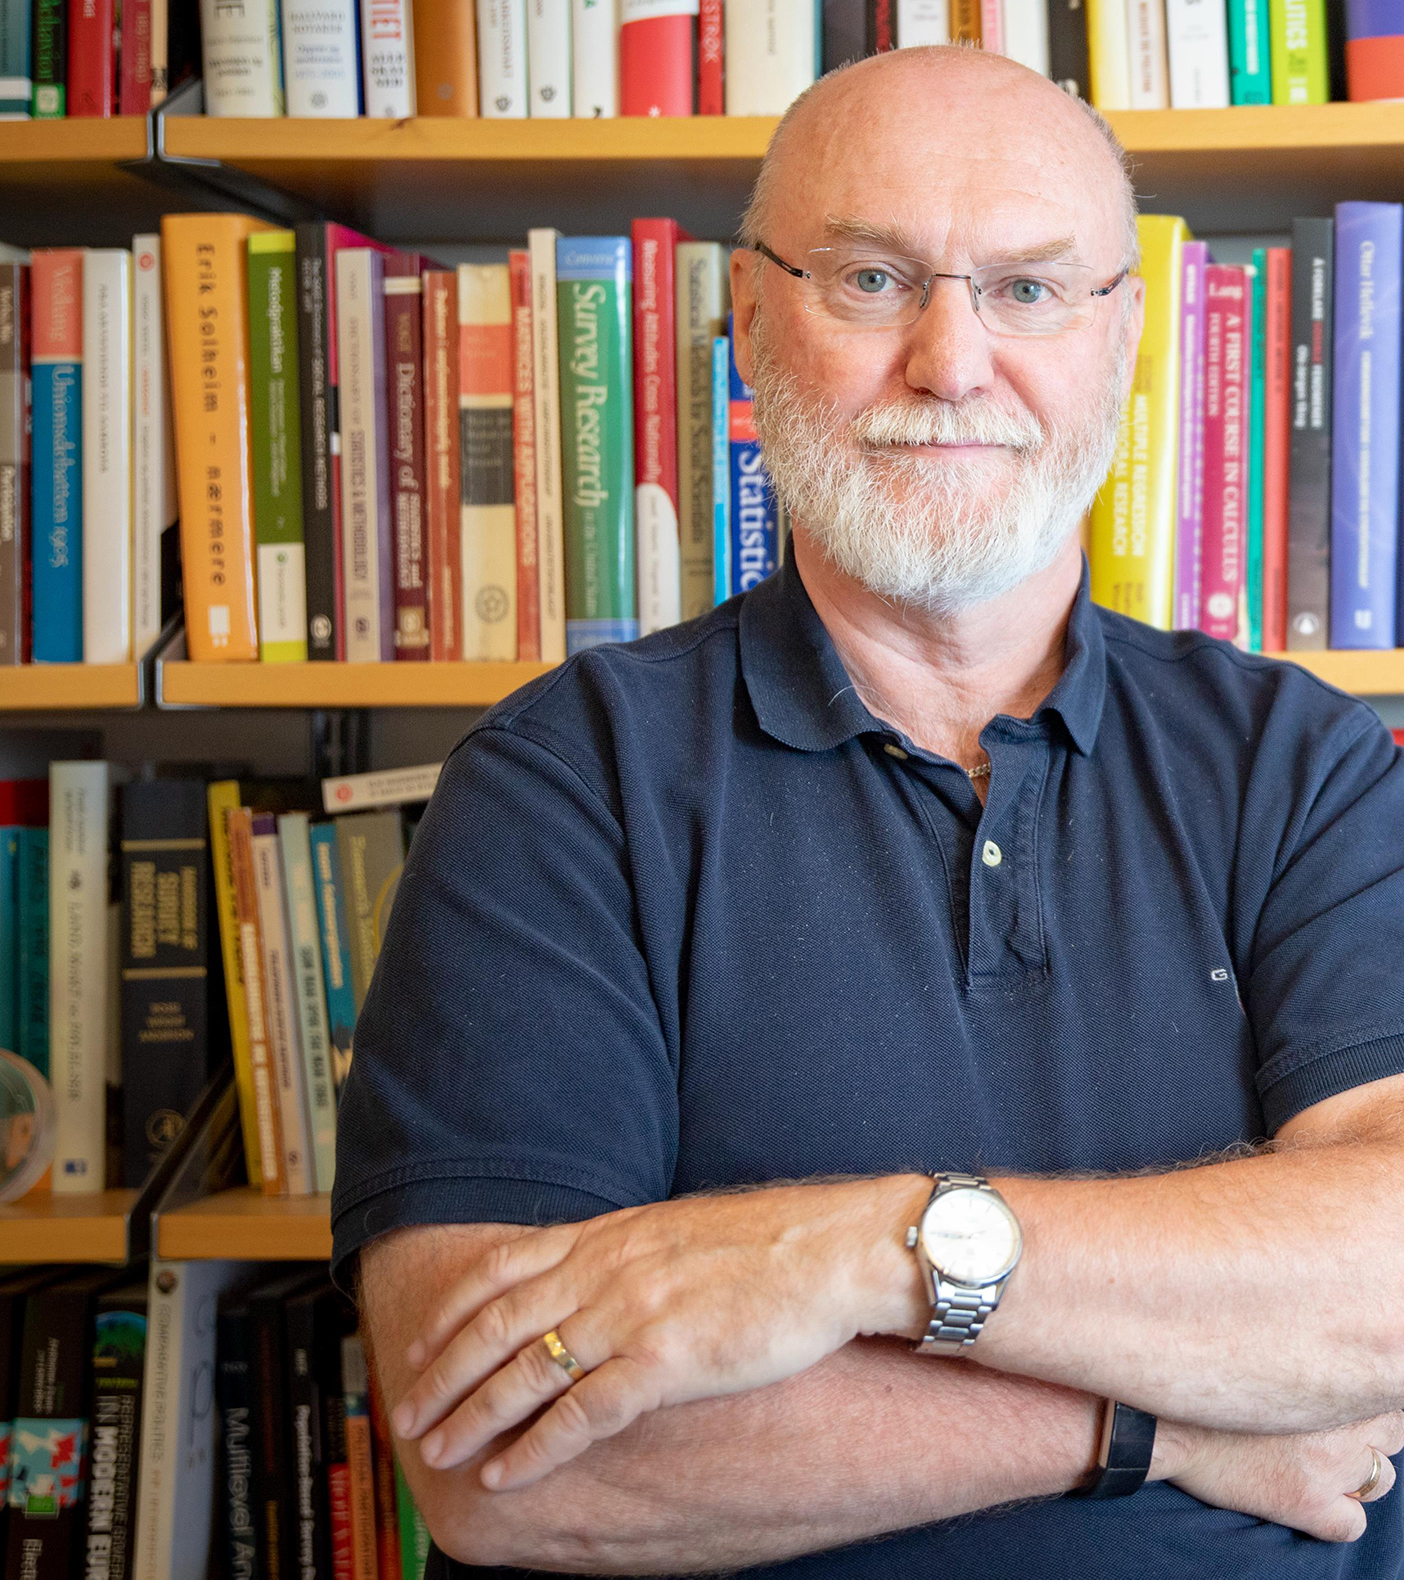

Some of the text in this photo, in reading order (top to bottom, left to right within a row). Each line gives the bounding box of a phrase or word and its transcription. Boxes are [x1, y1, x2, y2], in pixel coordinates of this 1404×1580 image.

[641, 239, 660, 309] Measuring
[1358, 240, 1375, 340] Ottar Hellevik
[643, 312, 660, 374] Attitudes
[1208, 312, 1221, 416] FOURTH EDITION
[196, 243, 228, 587] Erik Solheim nærmere
[313, 398, 325, 454] RESEARCH
[394, 362, 418, 491] Dictionary of
[517, 306, 536, 567] MATRICES WITH APPLICATIONS
[570, 283, 608, 508] Survey Research
[314, 457, 327, 509] METHODS
[1131, 394, 1148, 557] MULTIPLE REGRESSION
[1222, 313, 1240, 582] A FIRST COURSE IN CALCULUS
[48, 526, 71, 568] 1905
[1113, 481, 1128, 556] RESEARCH
[1211, 969, 1228, 981] G
[96, 1395, 119, 1423] IN
[90, 1426, 118, 1532] MODERN
[227, 1407, 254, 1535] Multilevel
